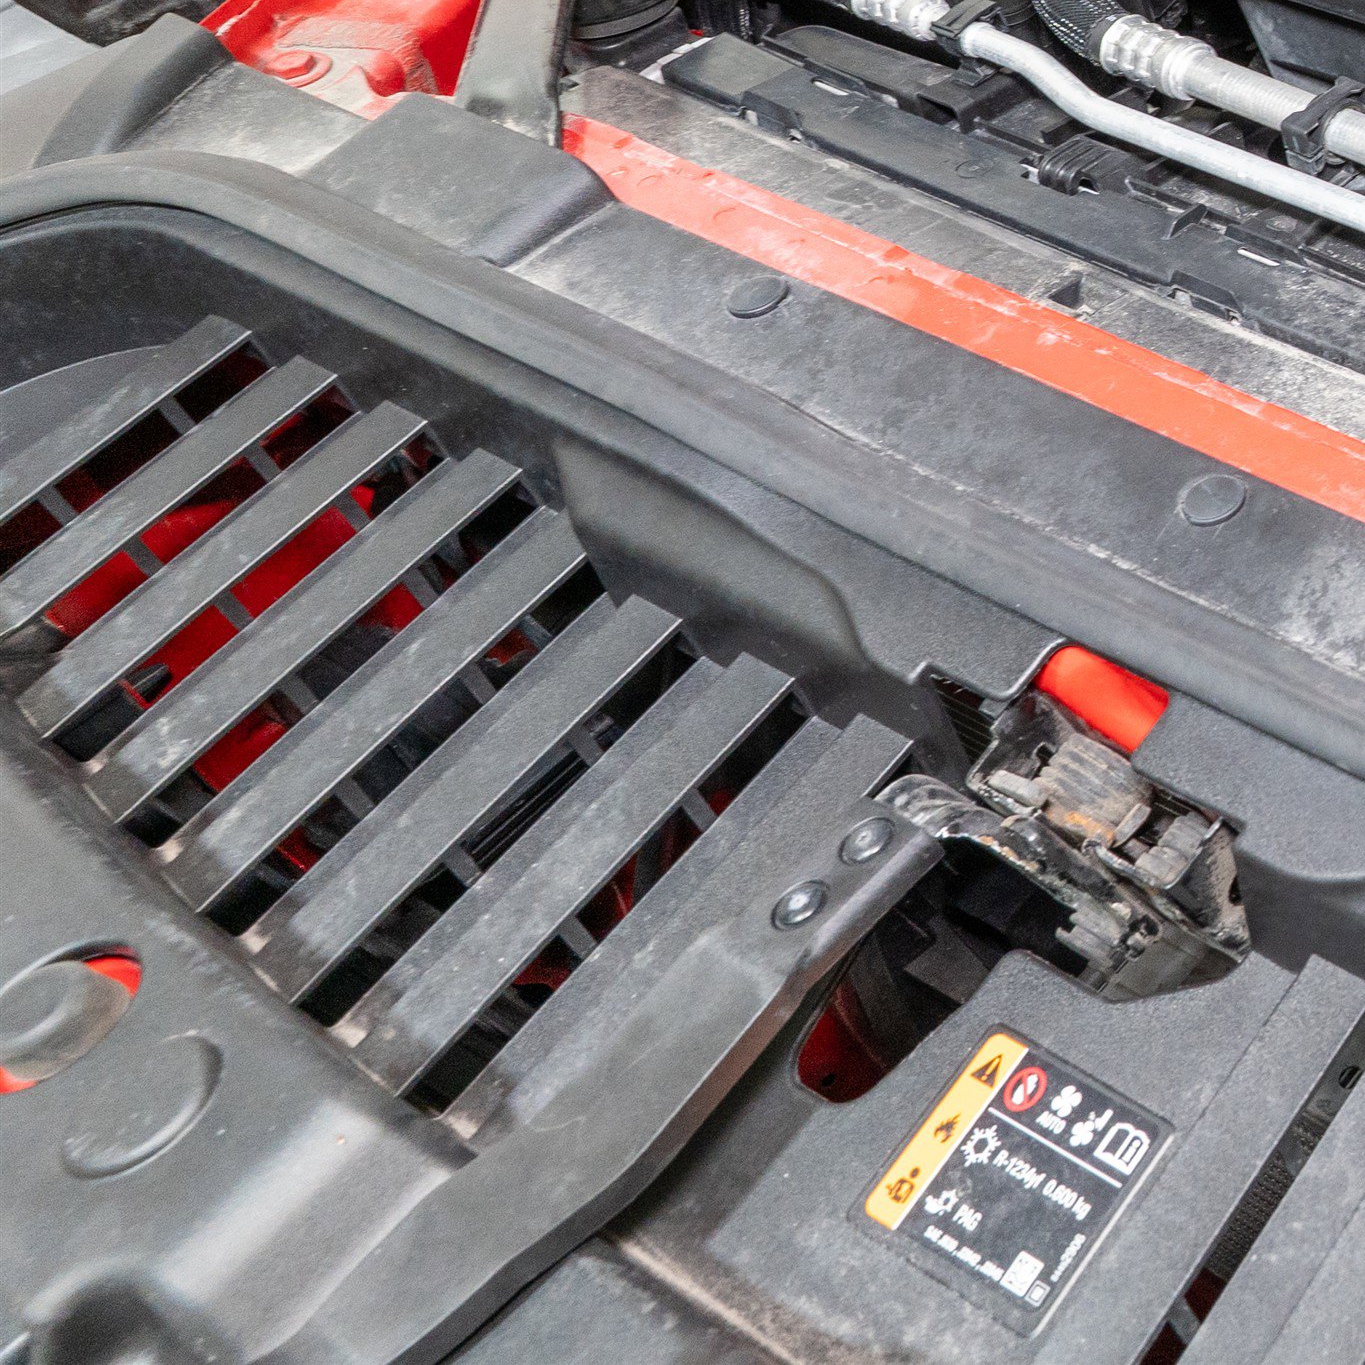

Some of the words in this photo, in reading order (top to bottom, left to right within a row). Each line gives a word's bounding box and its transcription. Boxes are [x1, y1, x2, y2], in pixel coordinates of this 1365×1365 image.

[1036, 1111, 1066, 1134] AUTO
[993, 1150, 1046, 1190] R-1234yf
[1072, 1196, 1092, 1221] kg
[953, 1204, 982, 1232] PAG
